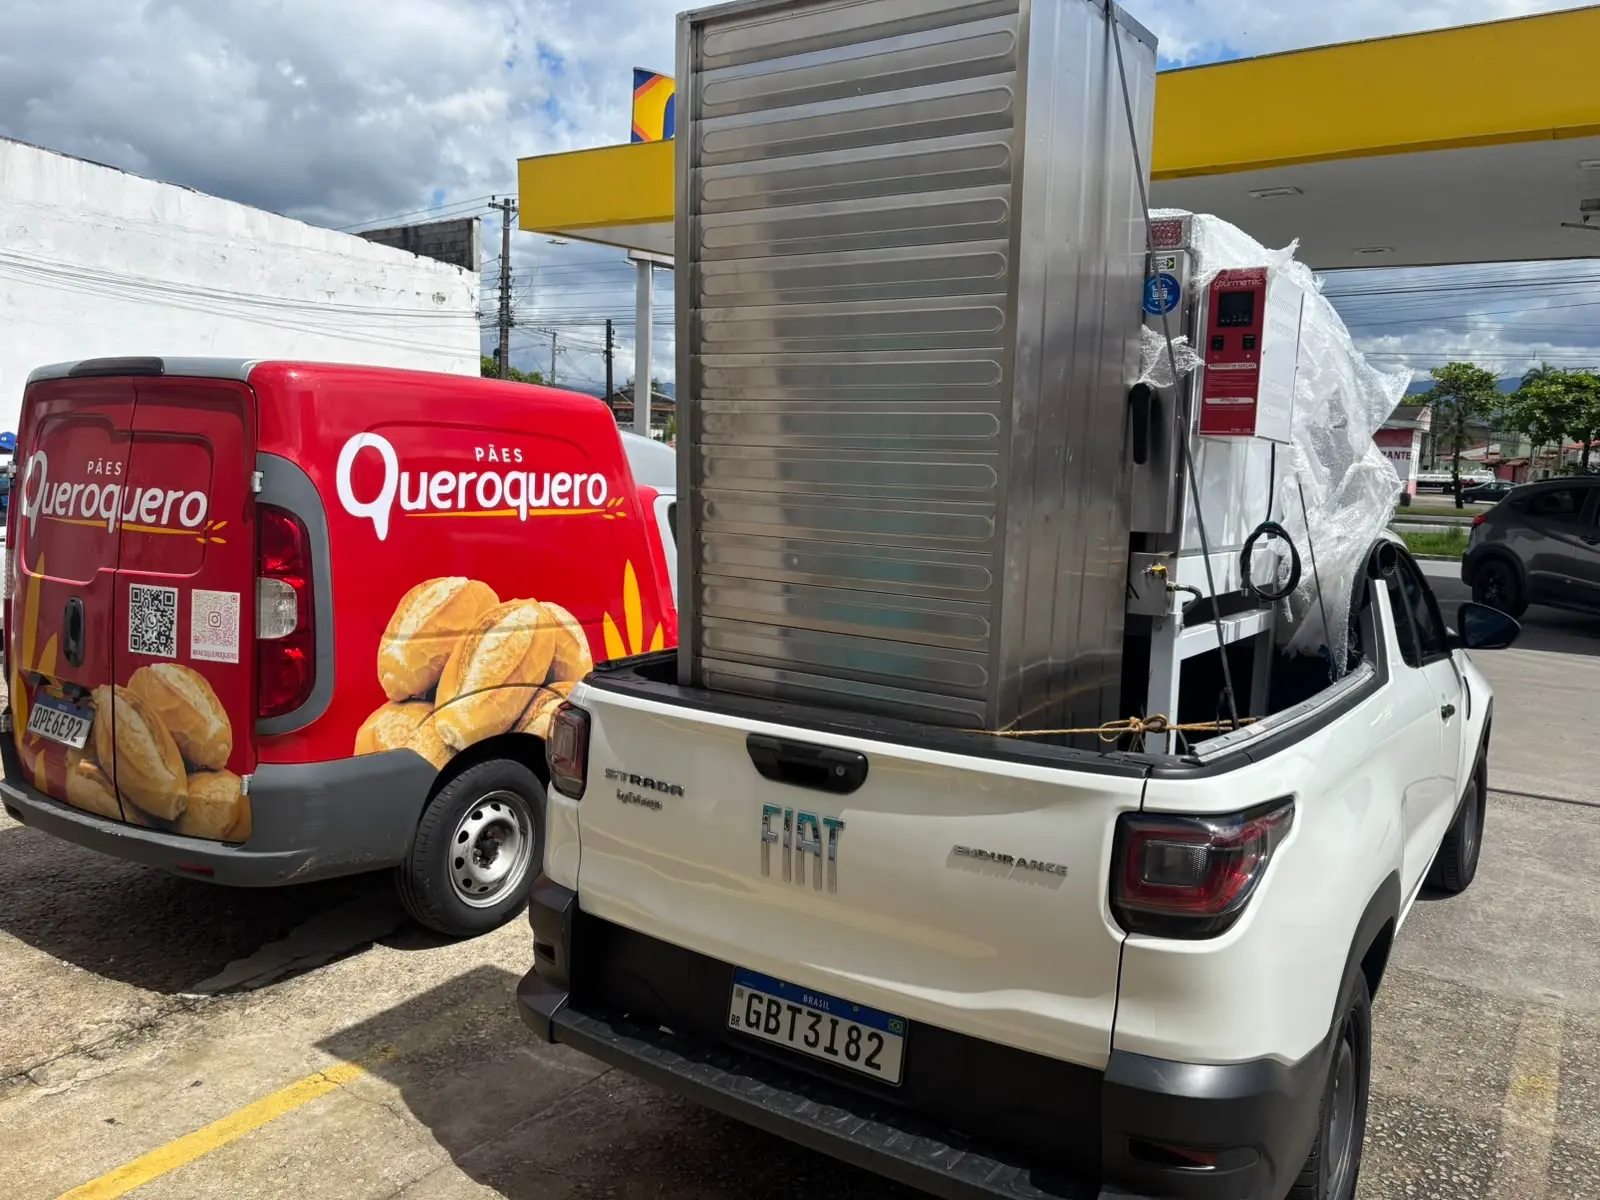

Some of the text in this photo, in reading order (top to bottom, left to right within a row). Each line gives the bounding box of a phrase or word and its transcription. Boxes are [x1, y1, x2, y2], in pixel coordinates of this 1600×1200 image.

[87, 458, 123, 476] PÃES
[475, 444, 523, 463] PÃES
[22, 450, 208, 538] Queroquero
[336, 432, 608, 541] Queroquero
[605, 768, 684, 797] STRADA
[761, 802, 846, 894] FIAT
[953, 845, 1068, 877] ENDURANCE
[803, 994, 831, 1010] BRASIL
[731, 1014, 741, 1028] BR
[745, 993, 884, 1070] GBT3I82
